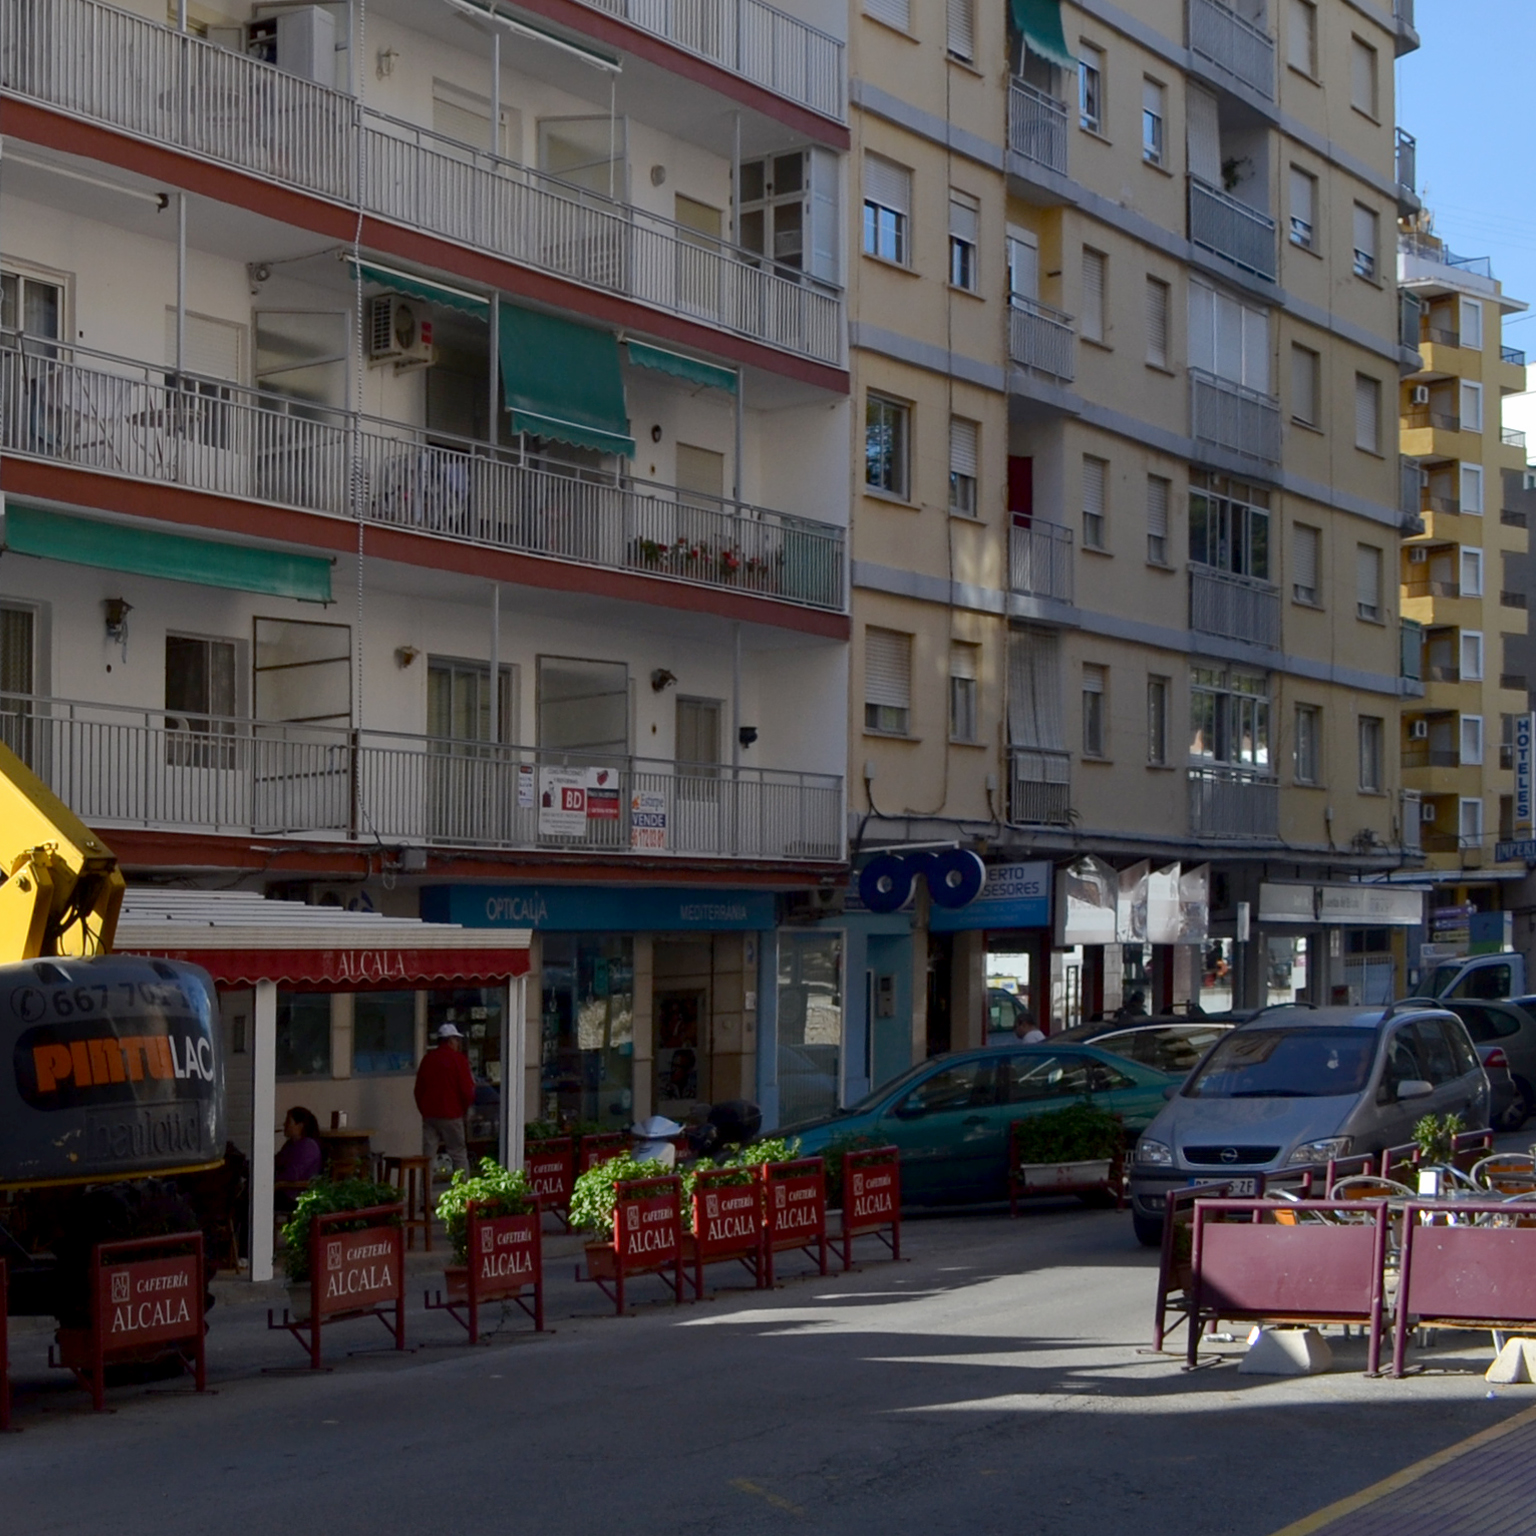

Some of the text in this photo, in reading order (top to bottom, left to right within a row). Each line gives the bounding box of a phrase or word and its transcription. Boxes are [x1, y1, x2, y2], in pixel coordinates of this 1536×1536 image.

[1517, 720, 1529, 817] HOTELES
[566, 790, 582, 809] BD
[632, 814, 664, 826] VENDE
[986, 867, 1024, 881] ERTO
[981, 882, 1040, 896] SESORES
[337, 950, 405, 976] ALCALA
[775, 1205, 818, 1231] ALCALA
[853, 1192, 892, 1218] ALCALA
[707, 1214, 755, 1241] ALCALA
[627, 1227, 676, 1255] ALCALA
[481, 1250, 533, 1279] ALCALA
[326, 1264, 393, 1298] ALCALA
[111, 1298, 191, 1333] ALCALA
